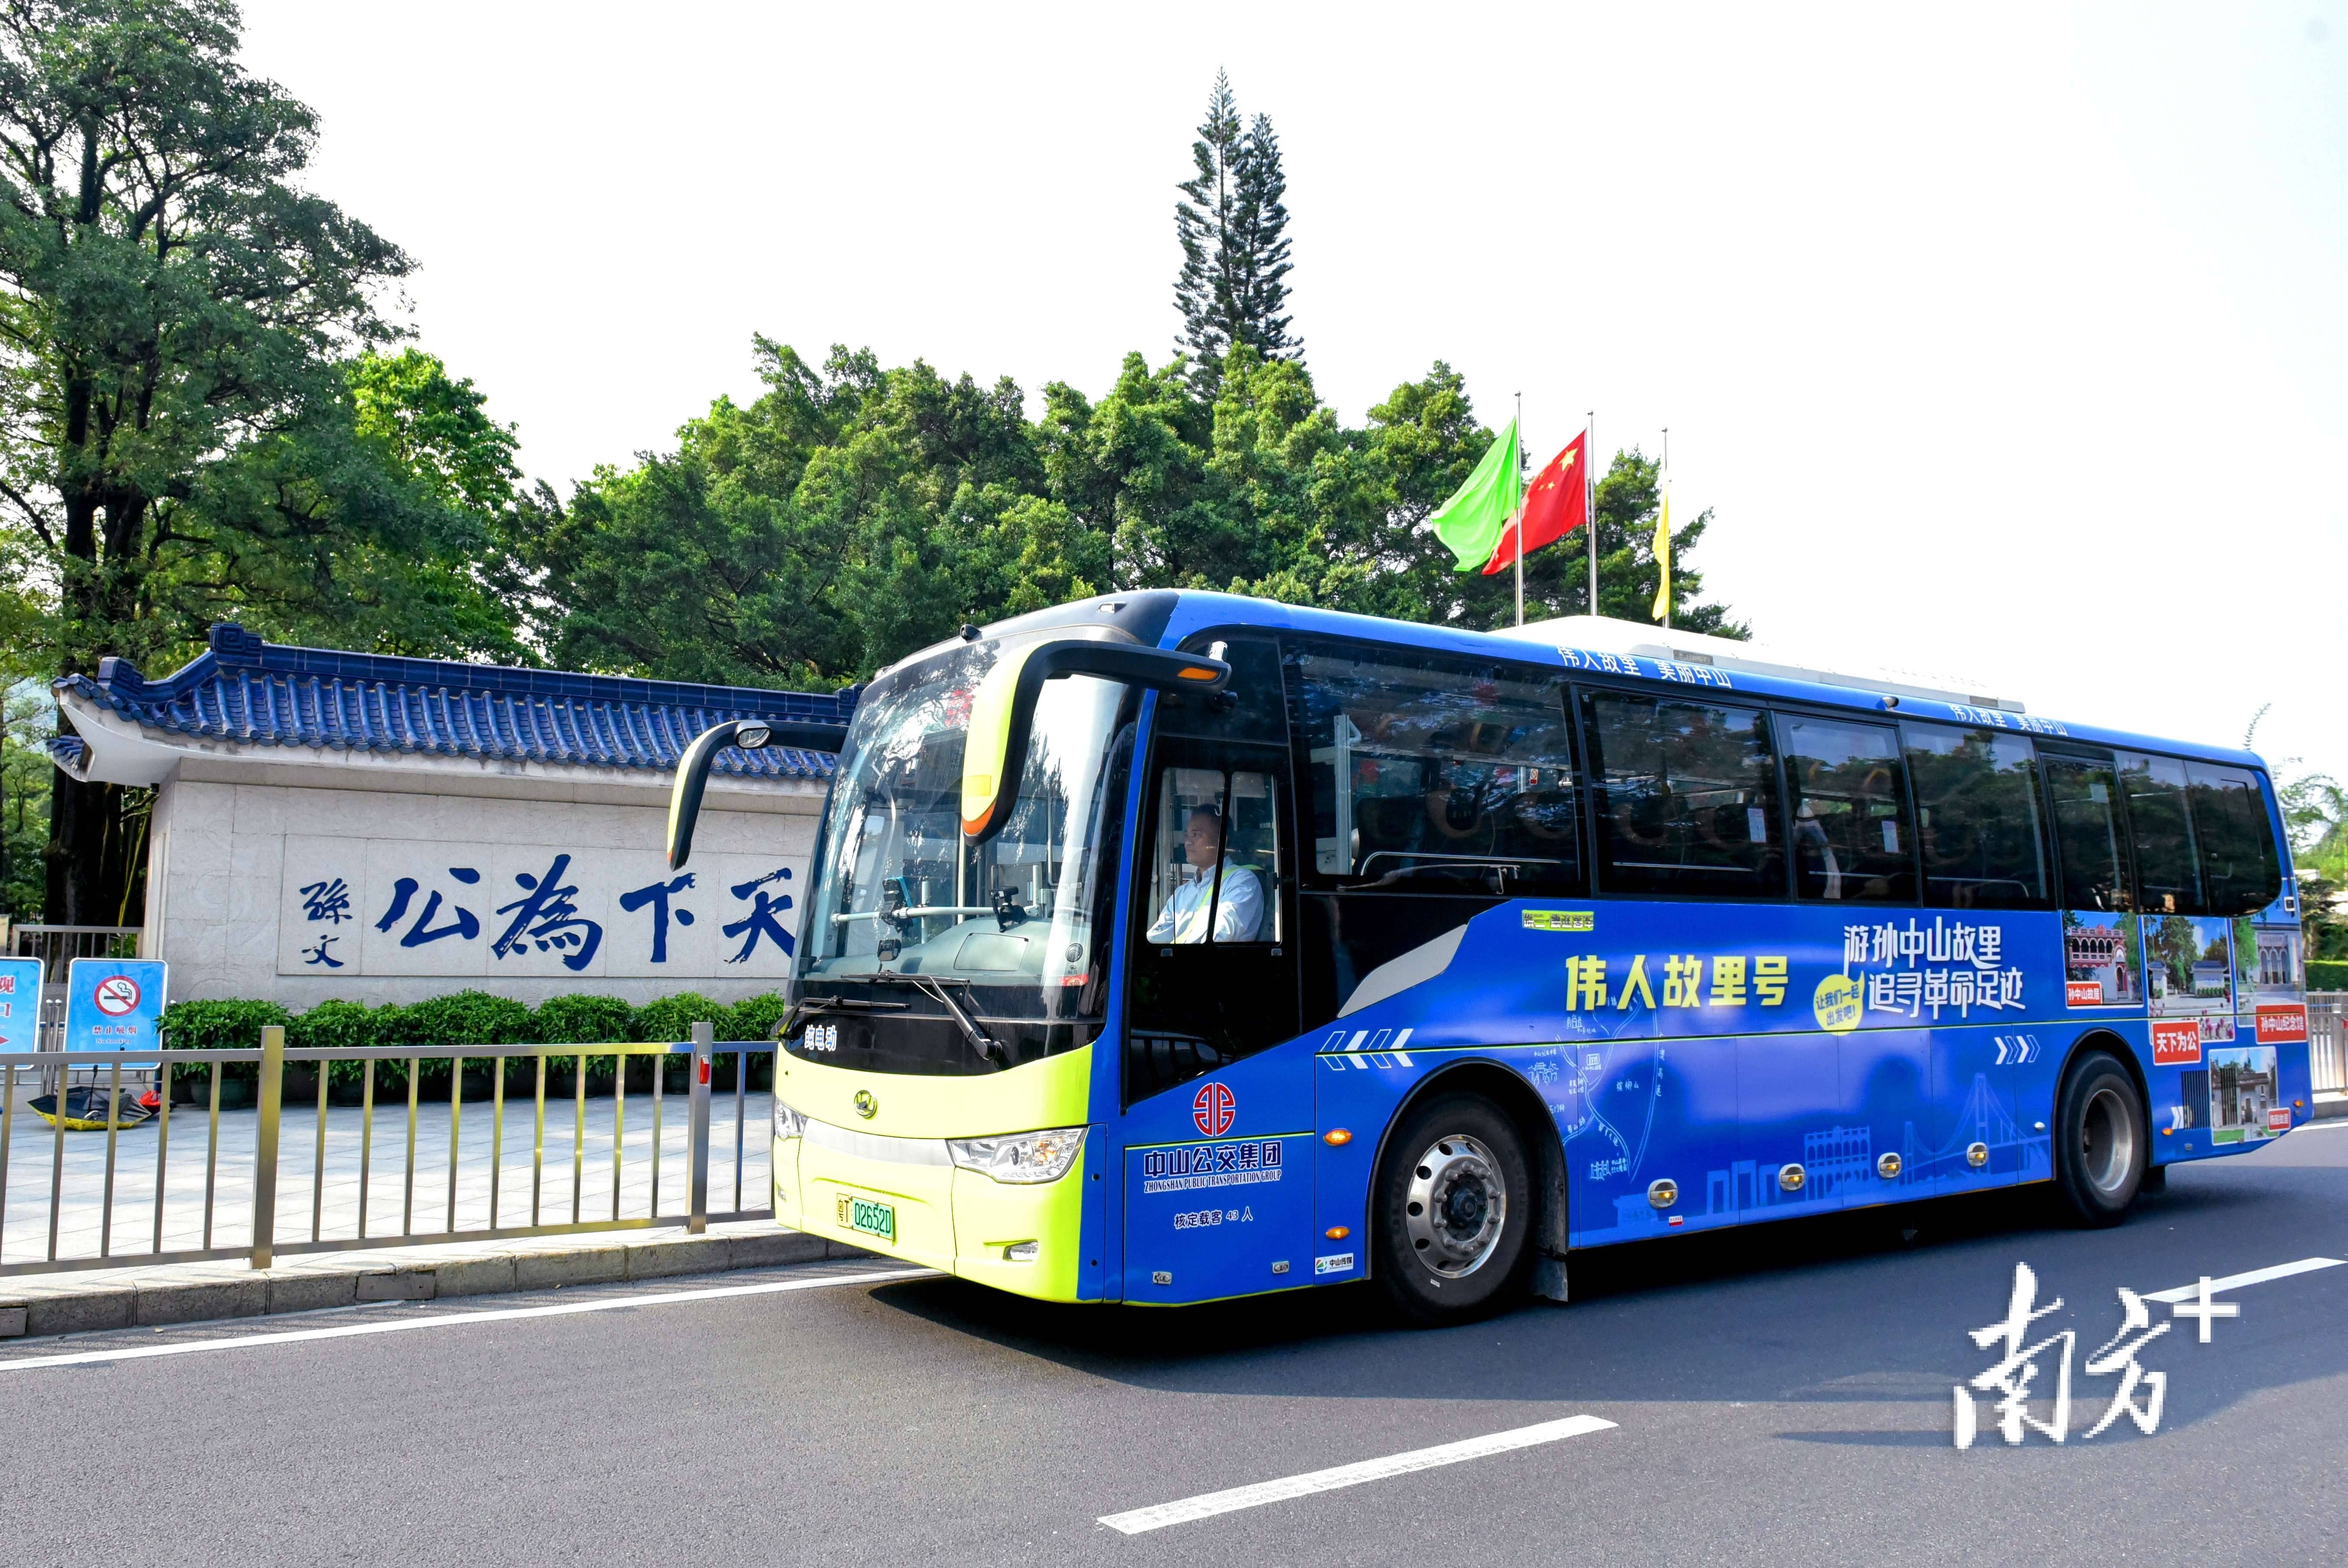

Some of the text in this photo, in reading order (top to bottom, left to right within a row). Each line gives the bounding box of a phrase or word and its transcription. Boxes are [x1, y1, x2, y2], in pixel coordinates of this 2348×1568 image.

[1558, 645, 1733, 689] 伟人故里 美丽中山
[1949, 704, 2068, 737] 伟人故里 美丽中山
[1844, 916, 2002, 977] 游孙中山故里
[1565, 954, 1789, 1011] 伟人故里号
[1868, 967, 2026, 1020] 追寻革命足迹
[2067, 987, 2100, 1001] 孙中山故居
[1816, 983, 1860, 1011] 让我们一起
[93, 1026, 137, 1035] 禁止吸烟
[2260, 1015, 2304, 1032] 孙中山纪念馆
[804, 1024, 837, 1052] 纯电动
[2156, 1031, 2197, 1053] 天下为公
[1144, 1140, 1282, 1178] 中山公交集团
[1144, 1169, 1282, 1193] ZHONGSHAN PUBLIC TRANSPORTATION GROUP
[1174, 1206, 1254, 1229] 核定载客 43 人
